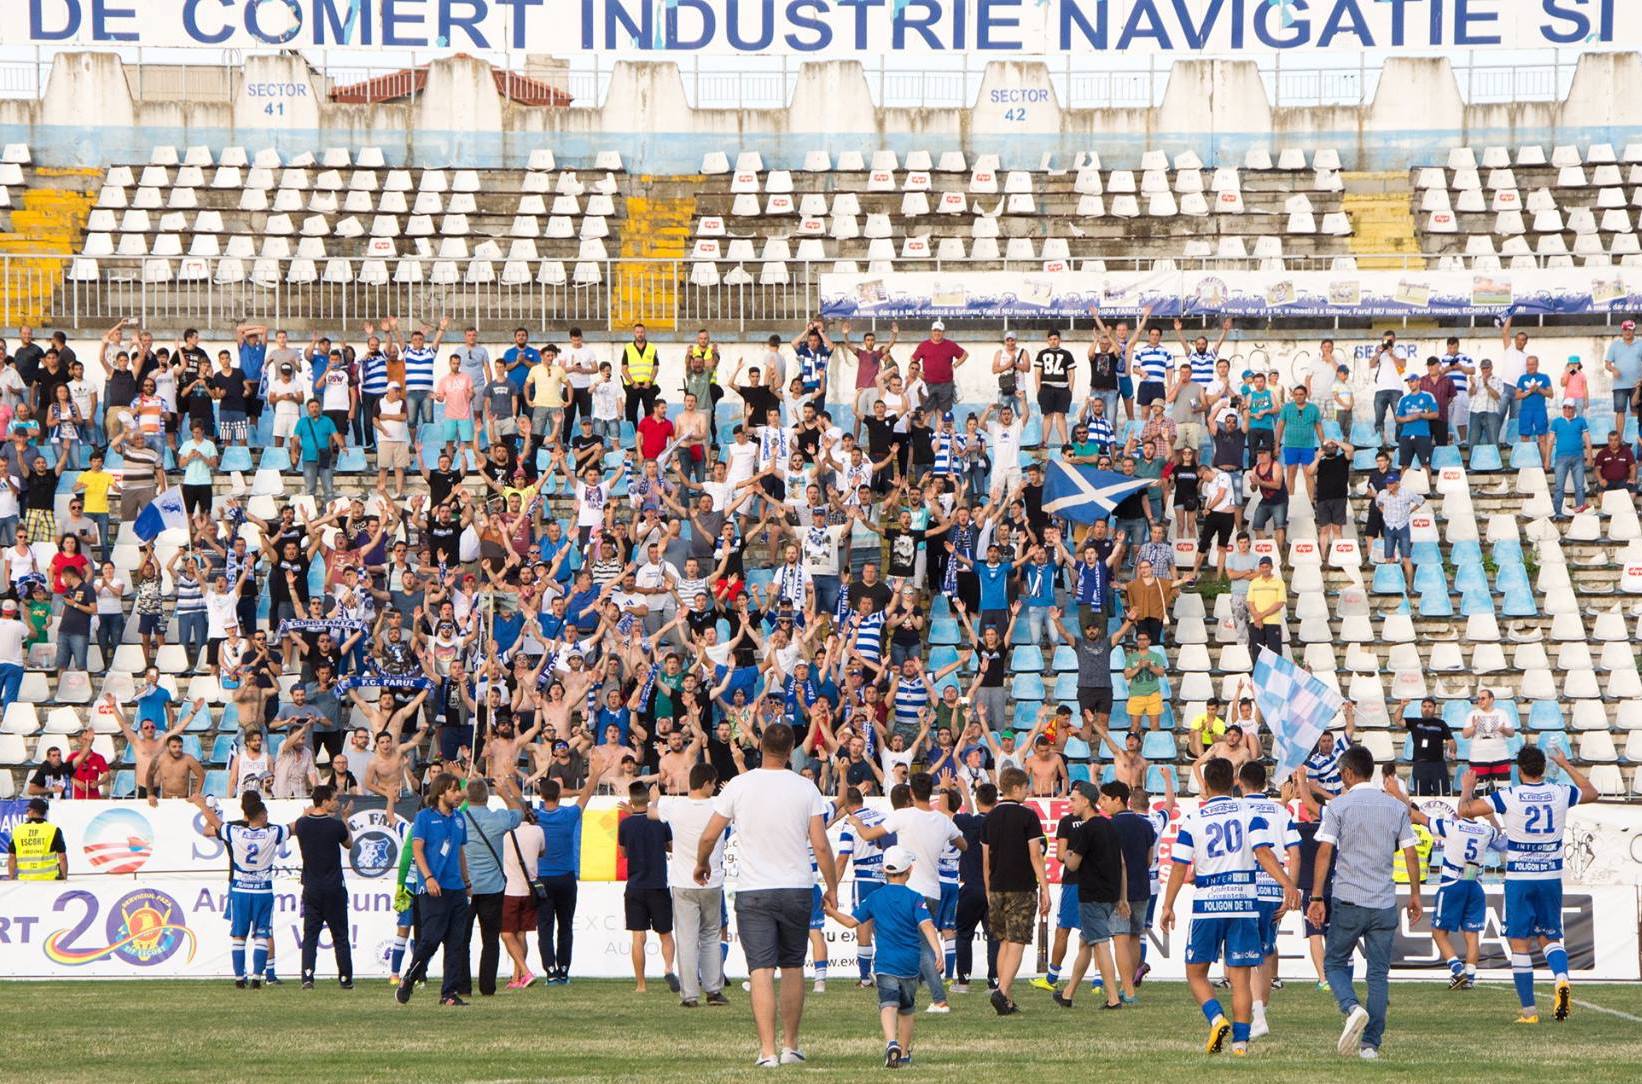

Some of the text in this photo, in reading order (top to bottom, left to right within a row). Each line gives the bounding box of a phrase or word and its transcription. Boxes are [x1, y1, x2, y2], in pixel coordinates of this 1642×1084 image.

[29, 0, 1615, 51] DE COMERT INDUSTRIE NAVIGATIE SI
[247, 83, 307, 97] SECTOR
[990, 89, 1048, 103] SECTOR
[264, 102, 285, 115] 41
[1005, 108, 1026, 121] 42
[1354, 344, 1418, 359] SEOR
[383, 679, 416, 687] FARUL
[1524, 804, 1556, 834] 21
[28, 829, 39, 837] ZIP
[1205, 819, 1243, 859] 20
[20, 837, 45, 847] ESCORT
[1464, 838, 1478, 860] 5
[245, 843, 260, 864] 2
[1204, 901, 1253, 911] POLIGON DE TIR
[604, 942, 661, 956] AUO
